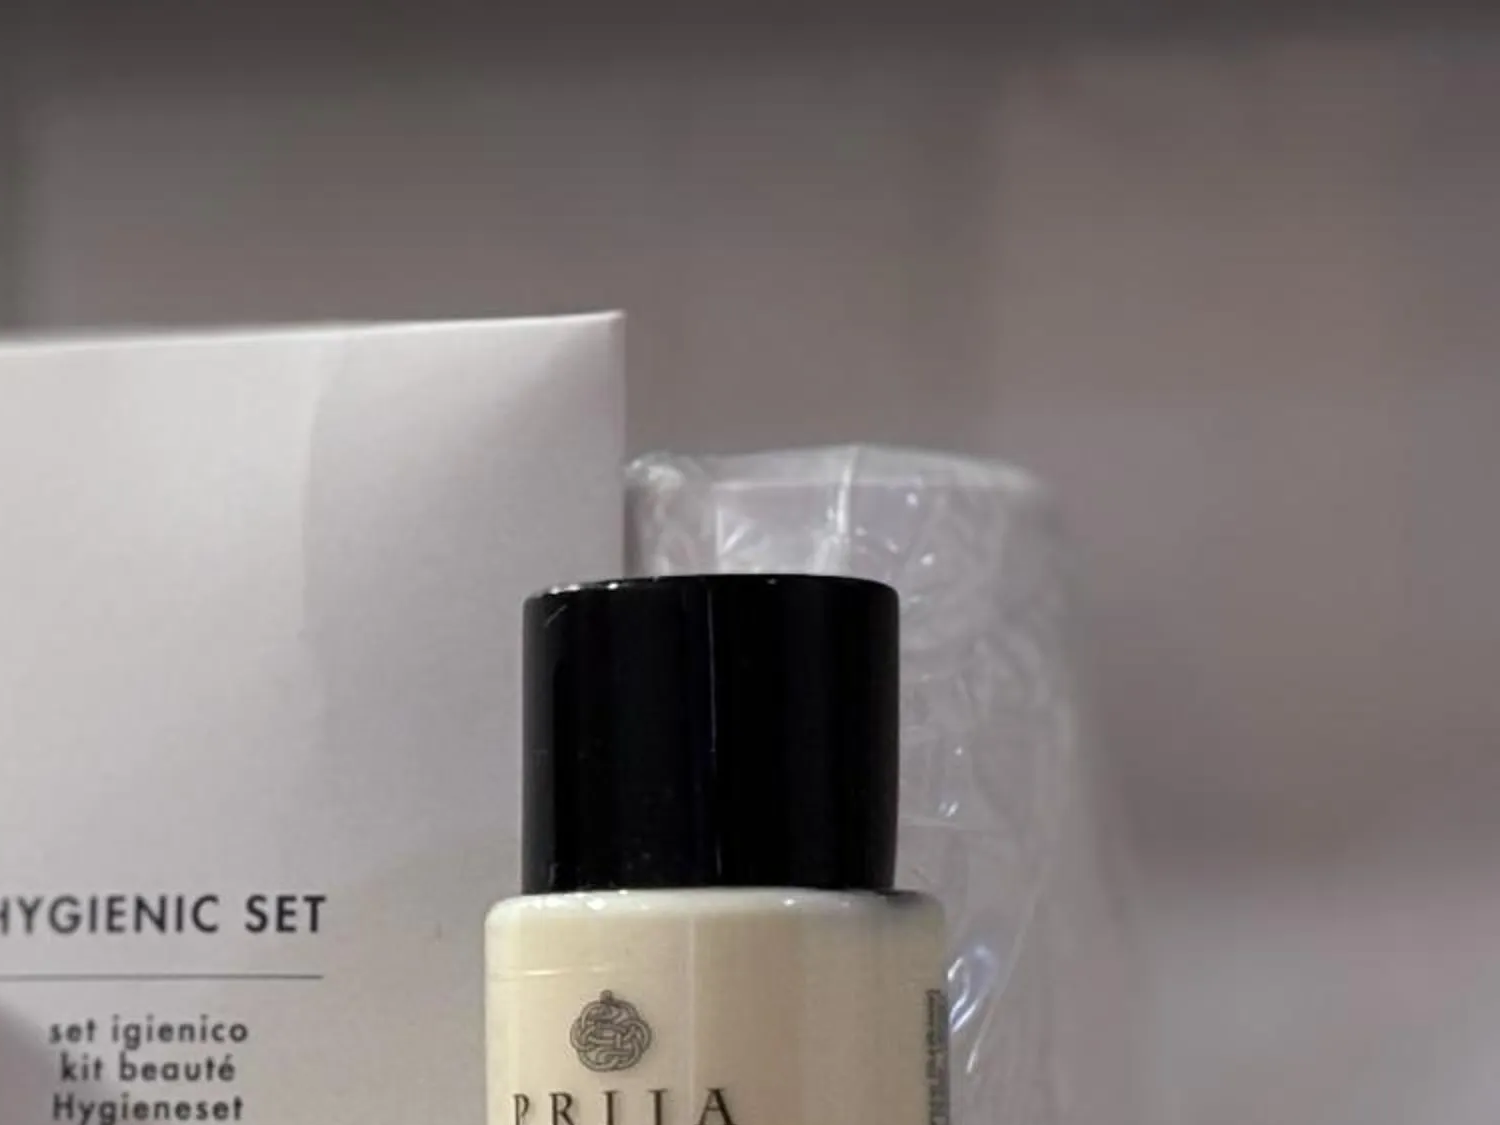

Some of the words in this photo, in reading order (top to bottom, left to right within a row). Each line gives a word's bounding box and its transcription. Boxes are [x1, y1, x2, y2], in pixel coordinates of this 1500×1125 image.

[244, 893, 326, 934] SET
[49, 1019, 96, 1044] set
[112, 1013, 249, 1051] igienico
[60, 1052, 103, 1081] kit
[119, 1052, 236, 1082] beauté
